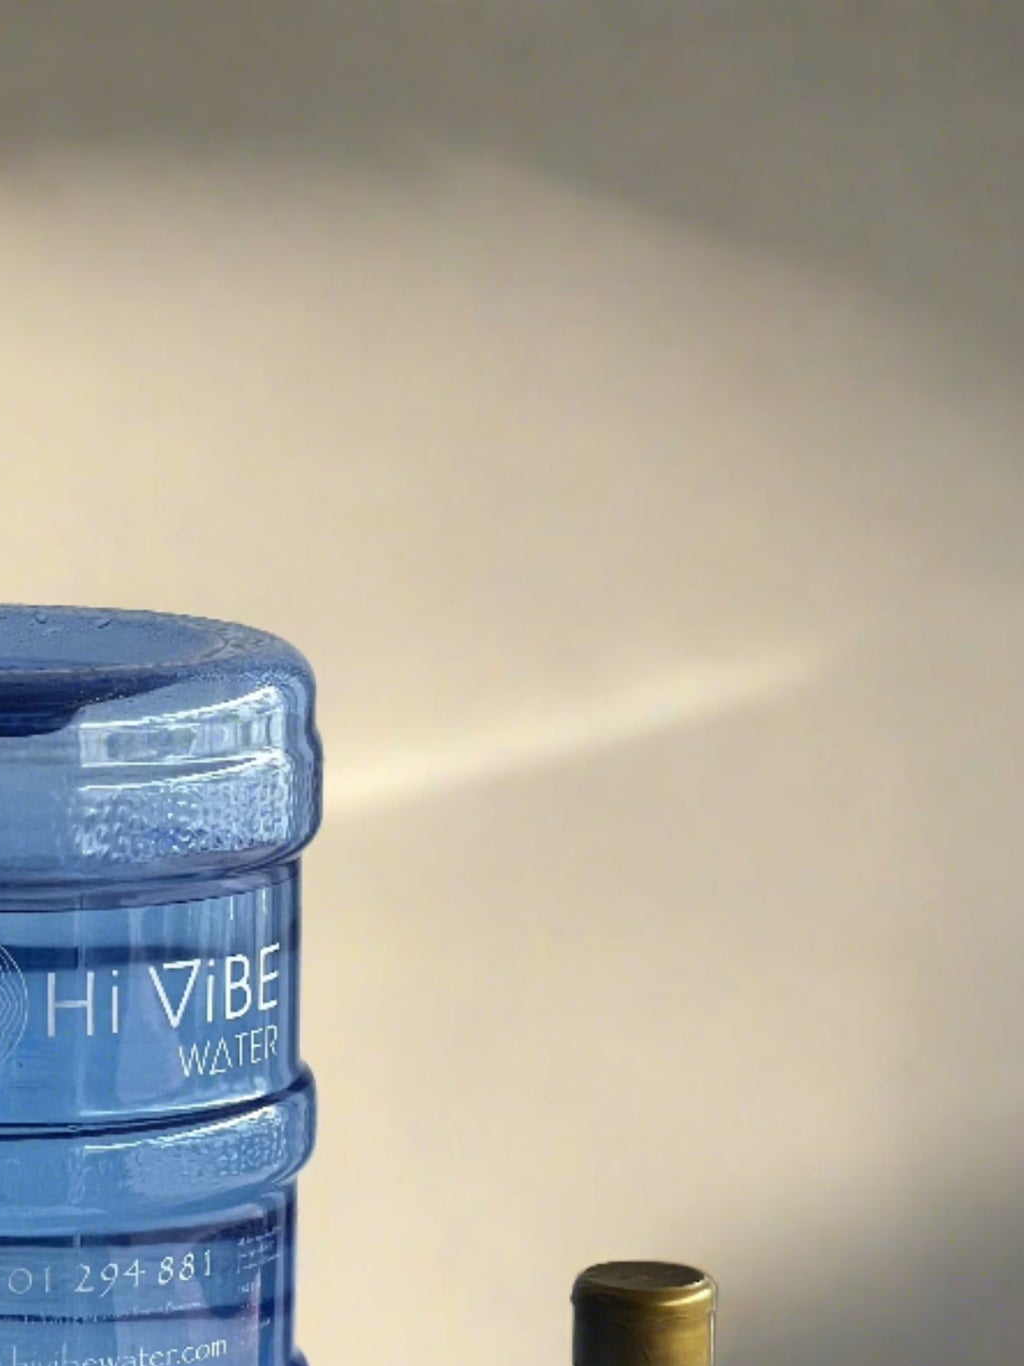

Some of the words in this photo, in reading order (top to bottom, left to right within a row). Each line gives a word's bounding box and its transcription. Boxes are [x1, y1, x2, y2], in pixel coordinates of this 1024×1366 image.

[47, 969, 119, 1037] Hi
[178, 1024, 279, 1077] WATER
[74, 1257, 146, 1297] 294
[157, 1249, 212, 1285] 881
